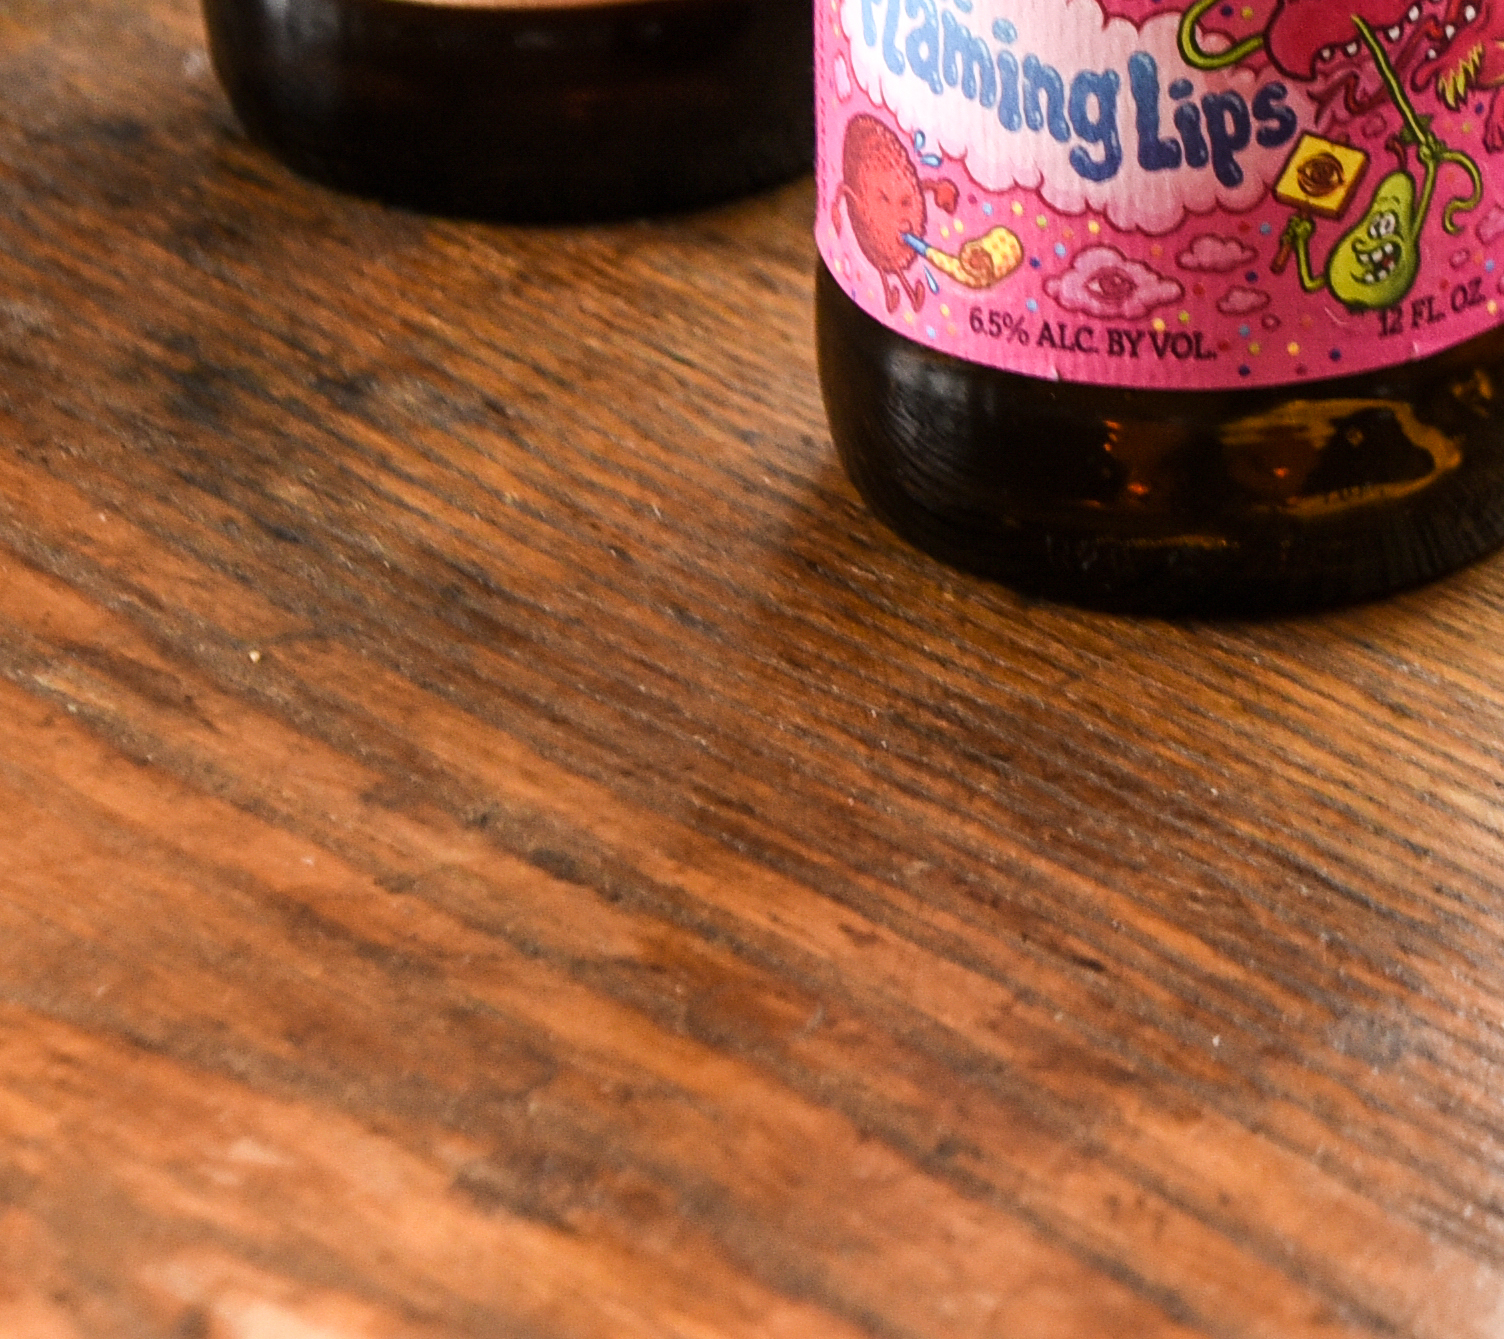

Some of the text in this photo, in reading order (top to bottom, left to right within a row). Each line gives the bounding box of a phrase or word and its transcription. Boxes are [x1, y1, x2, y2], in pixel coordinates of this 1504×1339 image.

[1128, 51, 1297, 188] Lips
[970, 307, 1217, 360] 6.5% ALC. BY VOL.
[1378, 307, 1402, 337] 12
